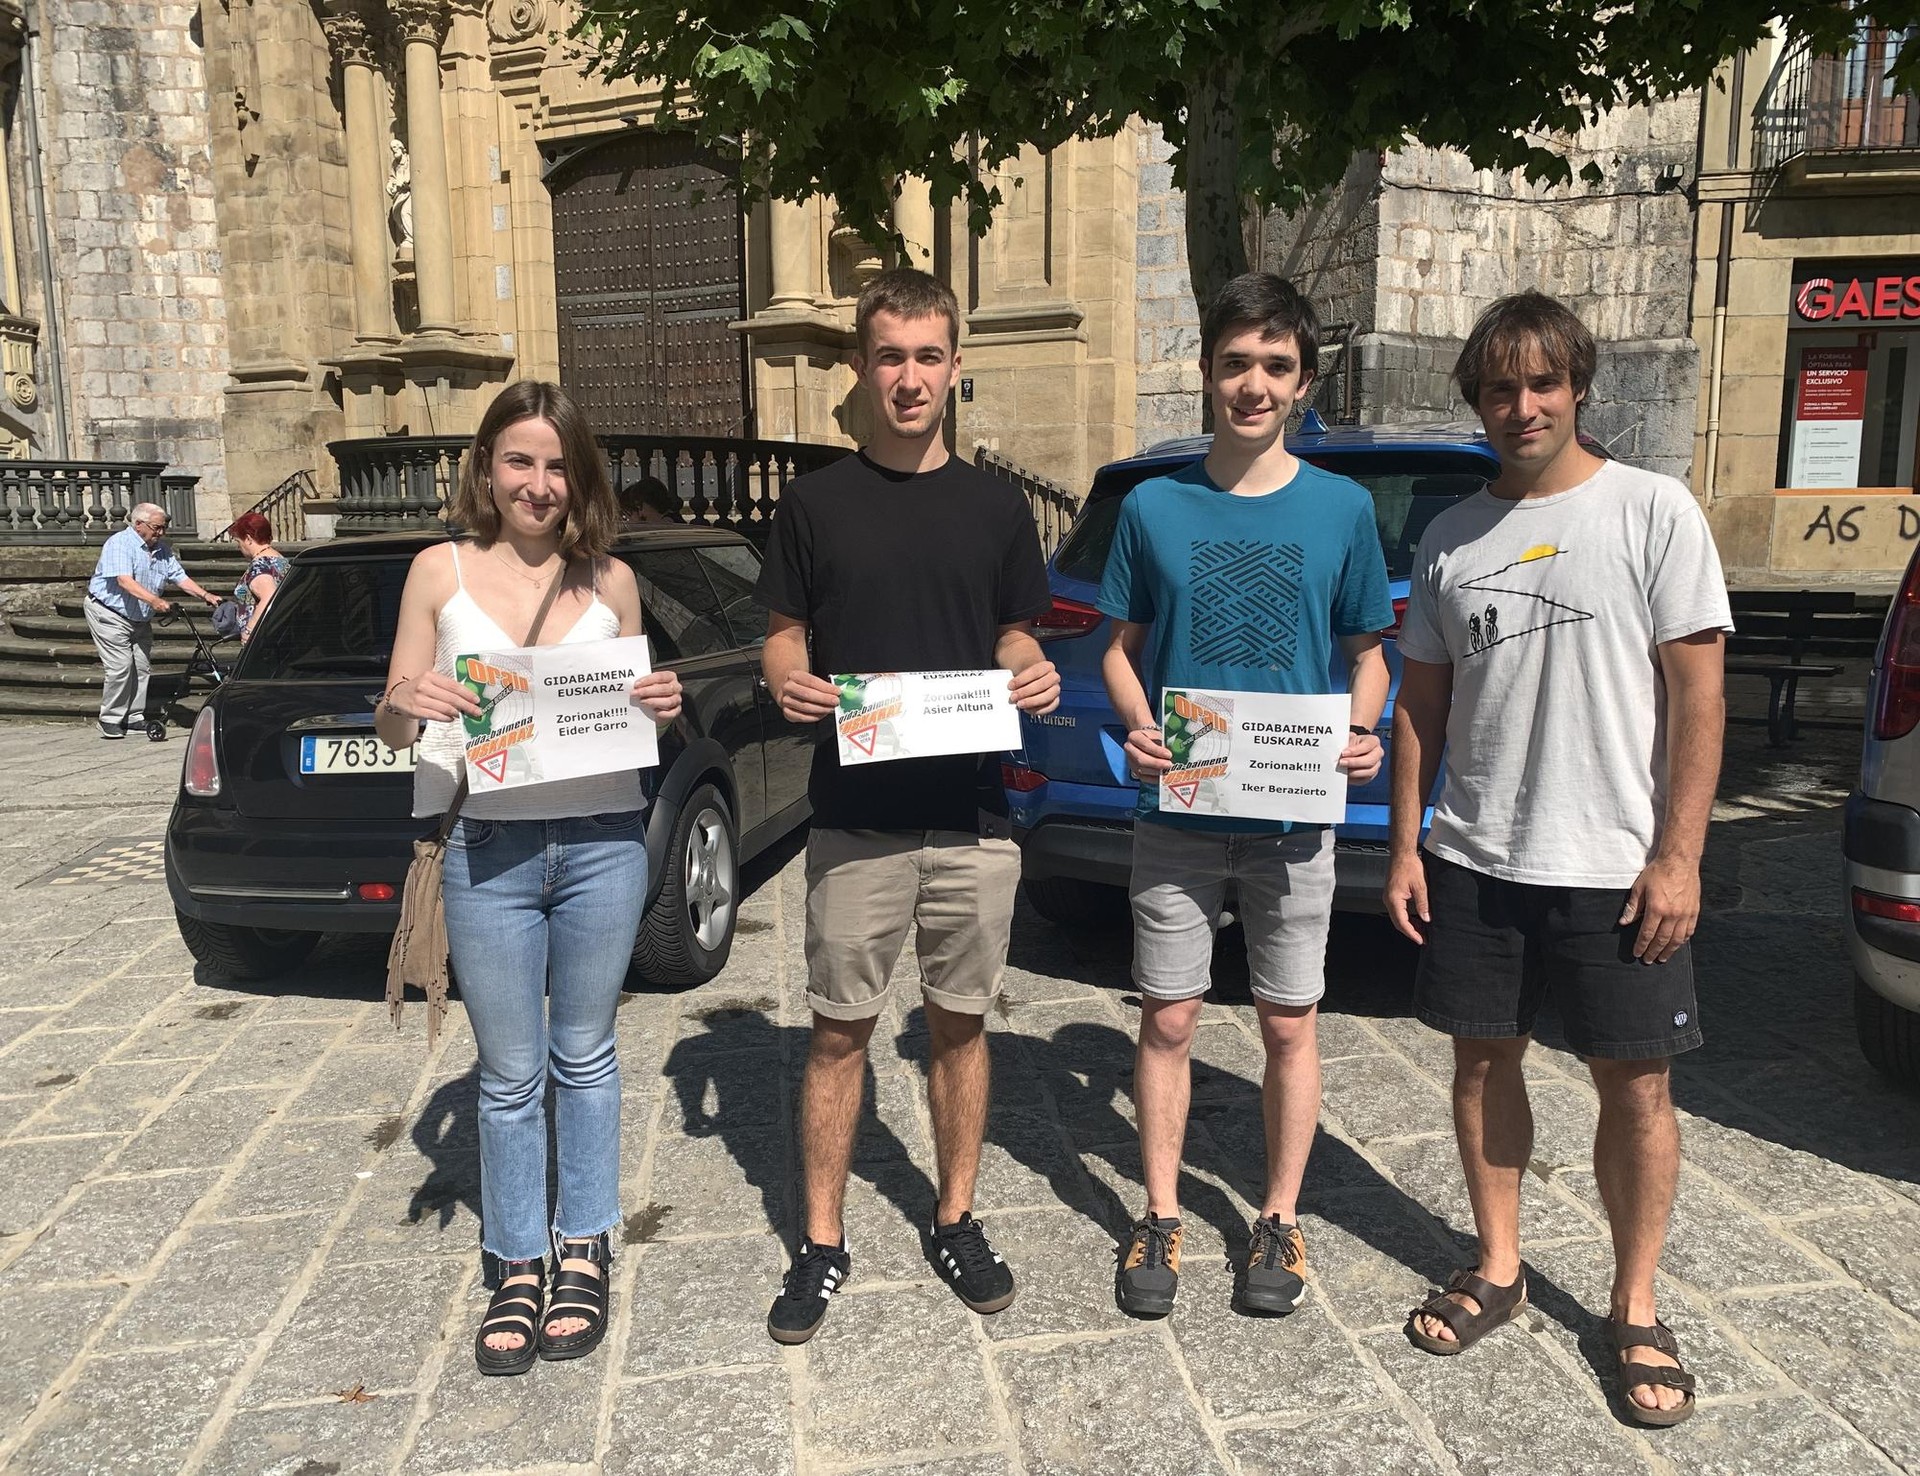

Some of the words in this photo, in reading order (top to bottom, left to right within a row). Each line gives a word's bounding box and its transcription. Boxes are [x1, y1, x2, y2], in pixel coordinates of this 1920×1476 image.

[1797, 276, 1920, 319] GAES
[543, 668, 635, 686] GIDABAIMENA
[557, 683, 624, 698] EUSKARAZ
[923, 689, 991, 703] Zorionak!!!!
[556, 707, 628, 724] Zorionak!!!!
[923, 704, 953, 715] Asier
[956, 702, 994, 712] Altuna
[1030, 714, 1076, 727] HYUNDAI
[559, 725, 590, 737] Eider
[594, 721, 628, 732] Garro
[1241, 722, 1333, 735] GIDABAIMENA
[1254, 735, 1320, 747] EUSKARAZ
[305, 757, 312, 766] E
[327, 739, 397, 768] 7633
[1249, 759, 1322, 772] Zorionak!!!!
[1241, 783, 1265, 792] Iker
[1268, 785, 1327, 796] Berazierto
